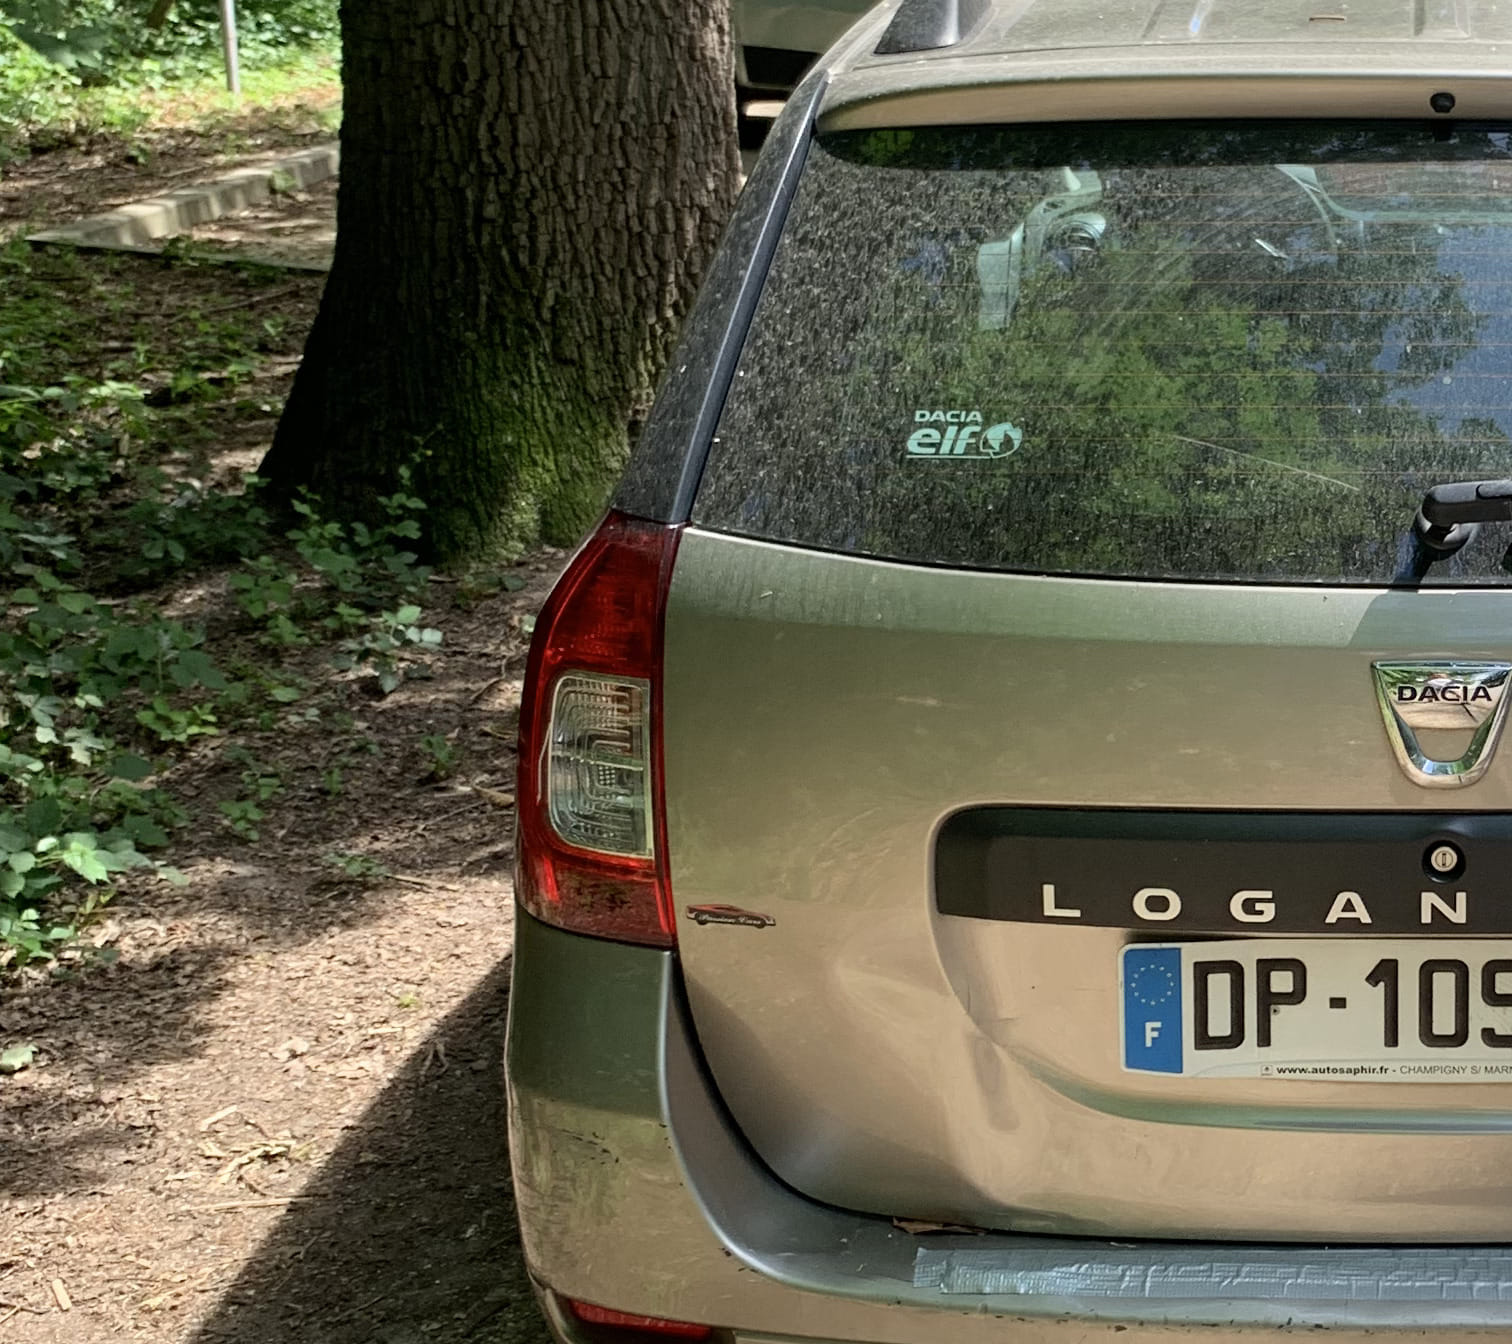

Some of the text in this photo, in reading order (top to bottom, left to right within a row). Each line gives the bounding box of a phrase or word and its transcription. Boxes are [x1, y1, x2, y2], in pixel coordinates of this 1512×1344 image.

[914, 410, 983, 422] DACIA
[907, 425, 982, 454] elf
[1397, 685, 1493, 702] DACIA
[1042, 883, 1467, 924] LOGAN
[1144, 1021, 1162, 1047] F
[1276, 1065, 1390, 1076] www.autosaphir.fr
[1400, 1065, 1468, 1075] CHAMPIGNY
